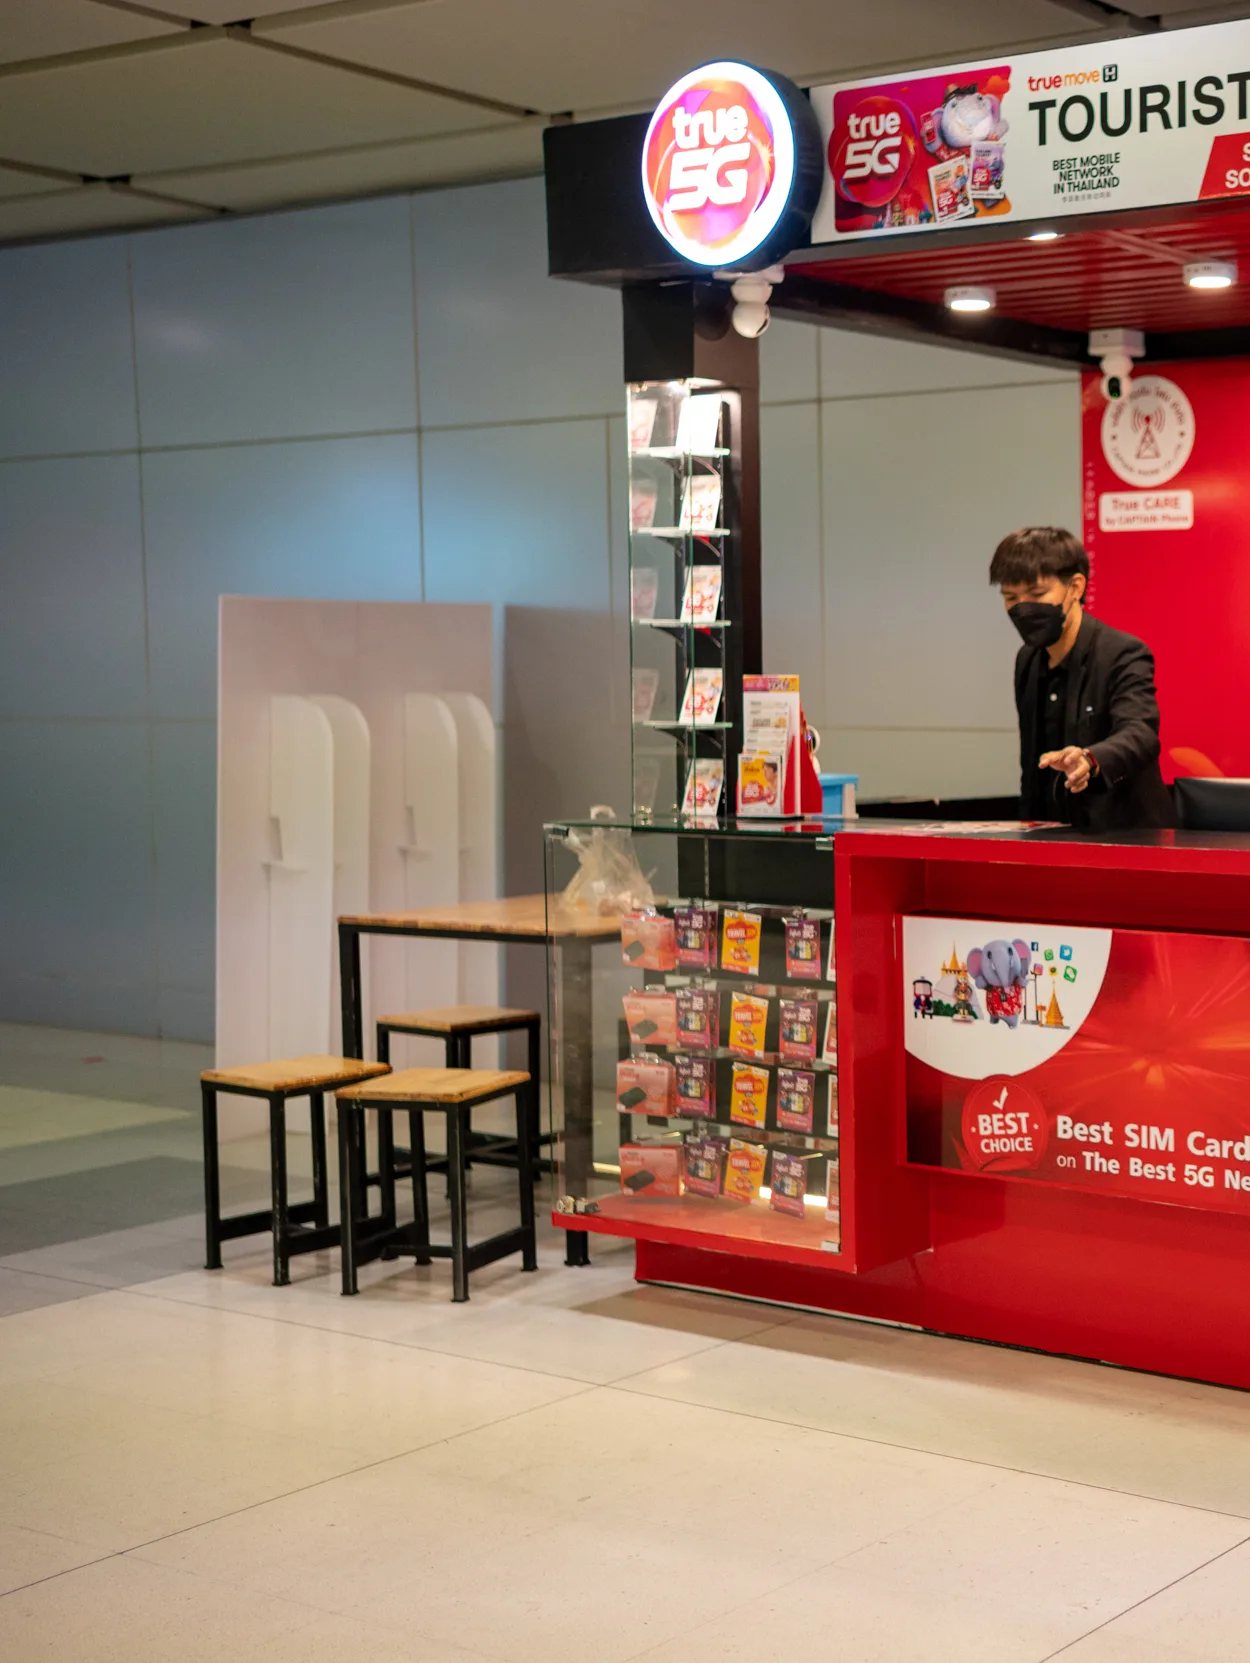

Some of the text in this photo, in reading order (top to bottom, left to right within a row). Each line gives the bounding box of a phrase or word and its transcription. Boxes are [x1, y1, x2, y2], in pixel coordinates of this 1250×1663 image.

[670, 104, 749, 145] true
[847, 112, 901, 139] true
[843, 136, 902, 179] 5G
[1053, 152, 1120, 171] BEST MOBILE
[666, 149, 754, 210] 5G
[1054, 177, 1120, 194] IN THAILAND
[1060, 165, 1114, 182] NETWORK
[978, 1113, 1030, 1137] BEST
[1056, 1115, 1114, 1146] Best
[1124, 1123, 1175, 1154] SIM
[980, 1136, 1034, 1155] CHOICE
[1056, 1154, 1077, 1169] on
[1082, 1150, 1121, 1175] The
[1128, 1157, 1176, 1184] Best
[1183, 1165, 1215, 1189] 5G
